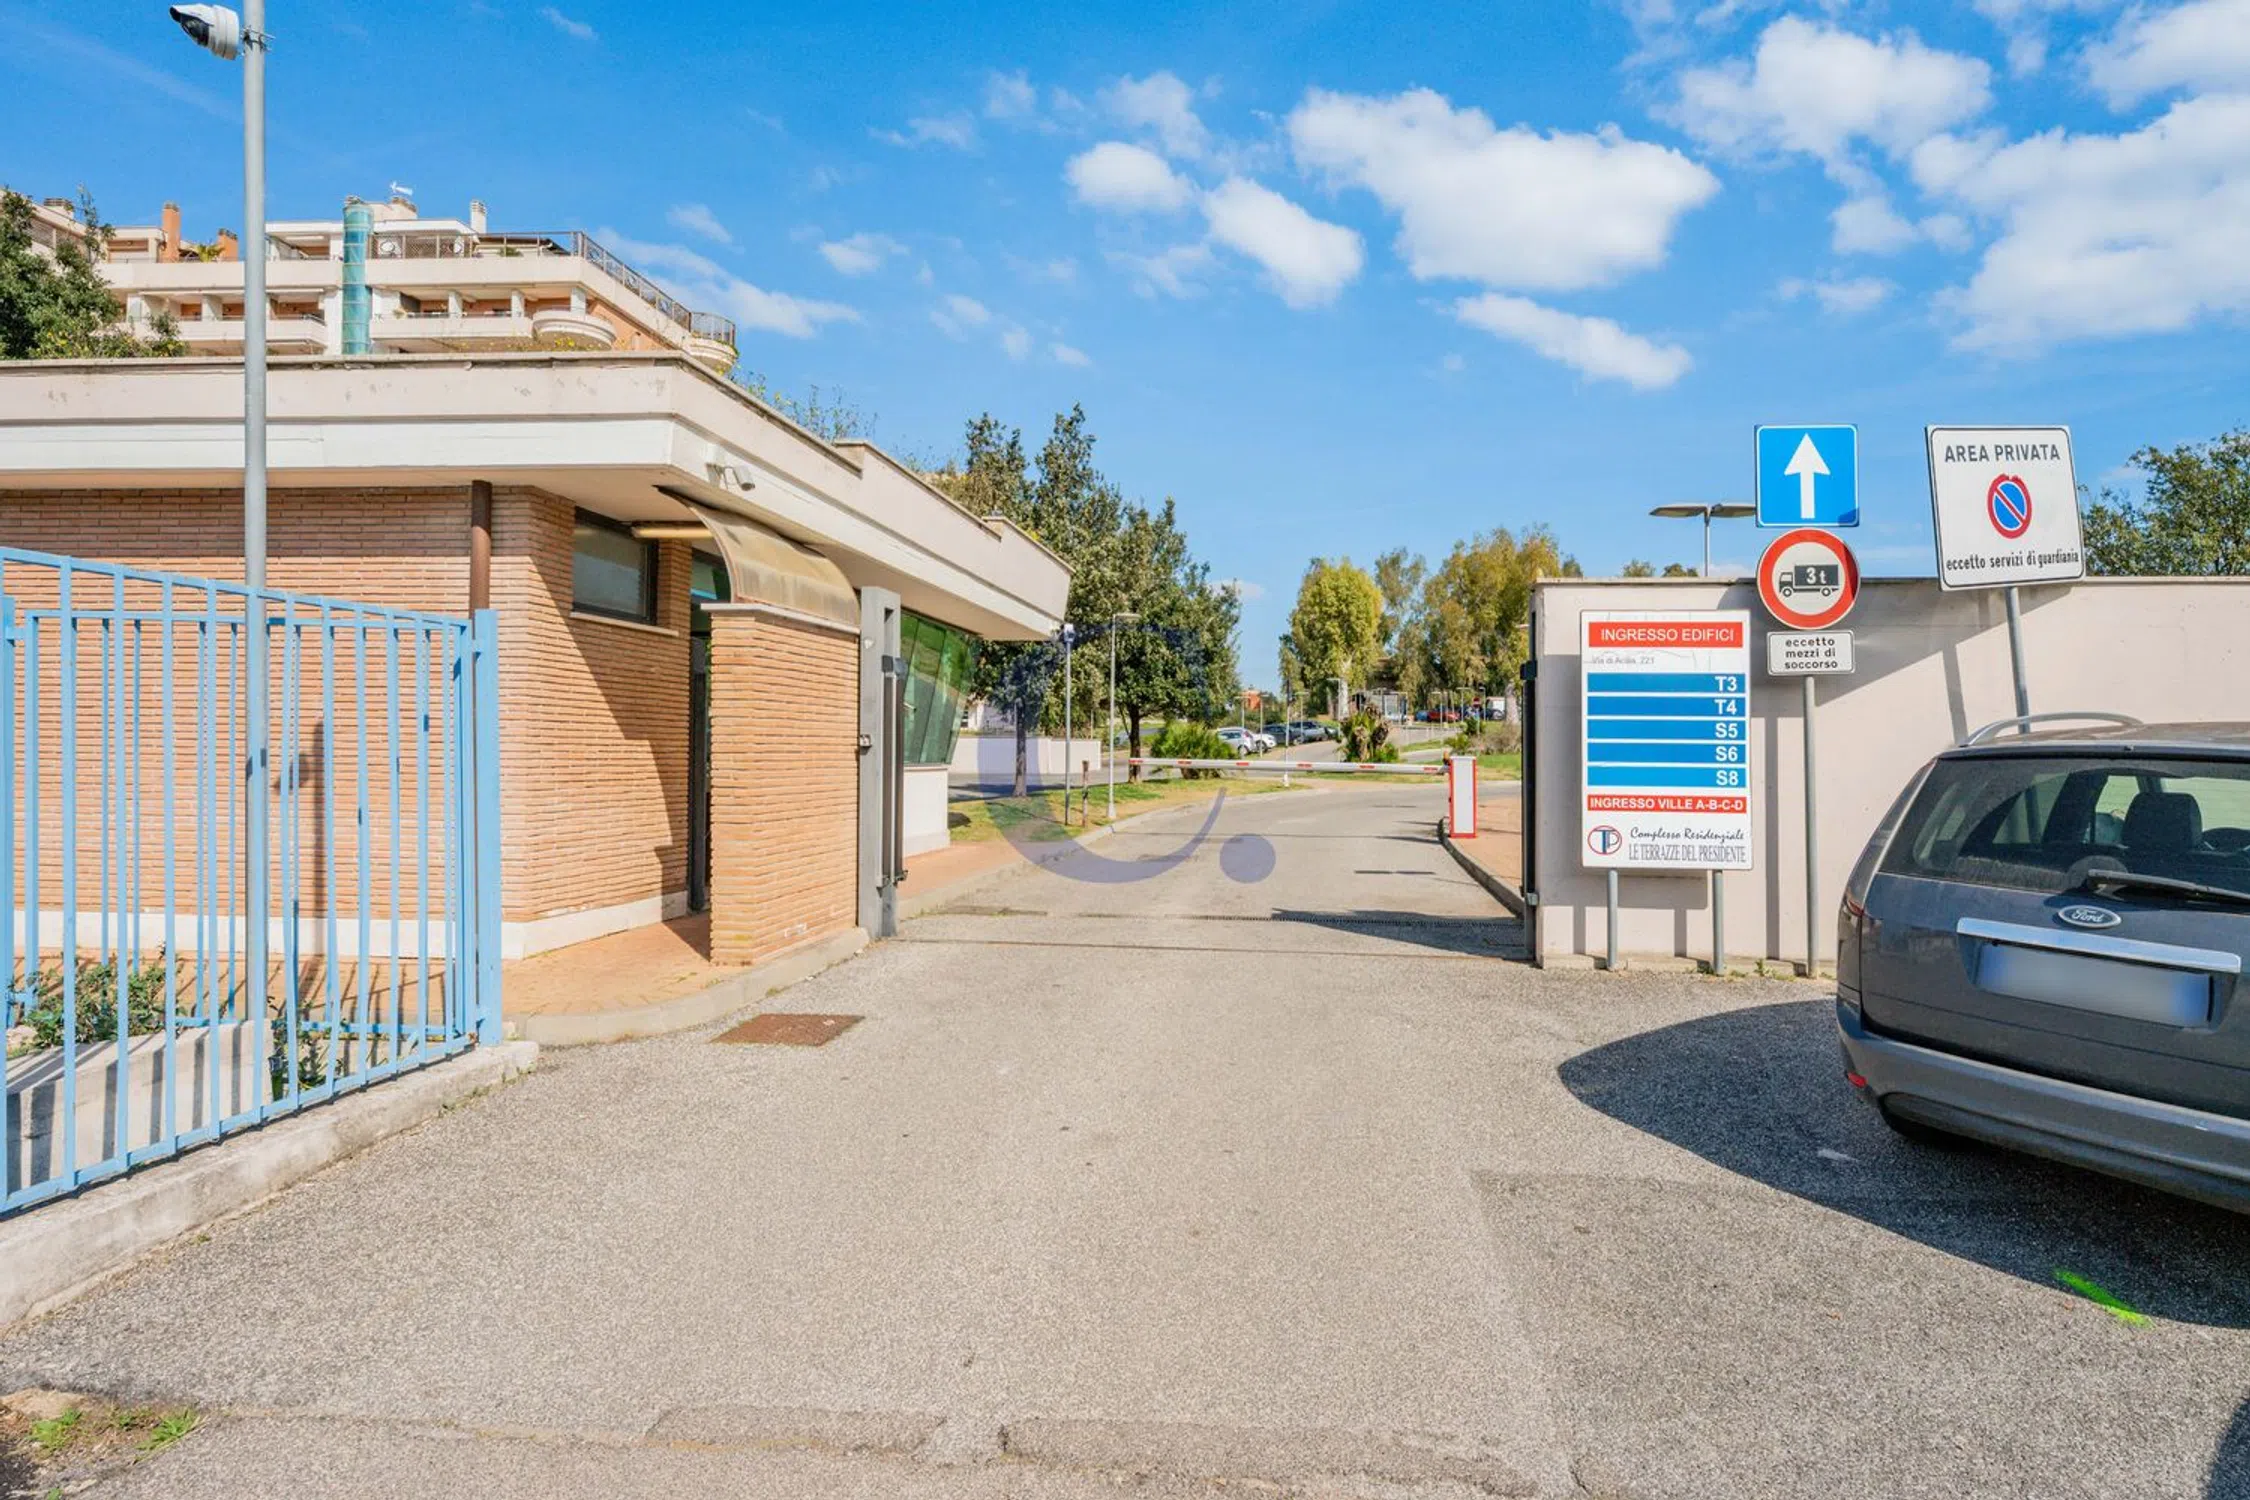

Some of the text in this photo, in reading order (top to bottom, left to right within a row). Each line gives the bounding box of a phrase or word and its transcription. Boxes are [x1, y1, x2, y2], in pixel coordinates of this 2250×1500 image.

[1945, 444, 2060, 462] AREA PRIVATA
[1946, 548, 2079, 570] eccetto servizi di guardiania
[1601, 628, 1734, 641] INGRESSO EDIFICI
[1785, 637, 1835, 647] eccetto
[1785, 647, 1836, 658] mezzi di
[1784, 659, 1838, 669] soccorso
[1715, 676, 1737, 692] T3
[1714, 699, 1737, 715] T4
[1715, 723, 1738, 738] S5
[1715, 746, 1738, 762] S6
[1716, 770, 1739, 786] S8
[1590, 797, 1743, 811] INGRESSO VILLE A-B-C-D
[1630, 826, 1744, 843] Complesso Residenziale
[1629, 843, 1746, 862] LE TERRAZZE DEL PRESIDENTE
[2071, 908, 2105, 922] Ford
